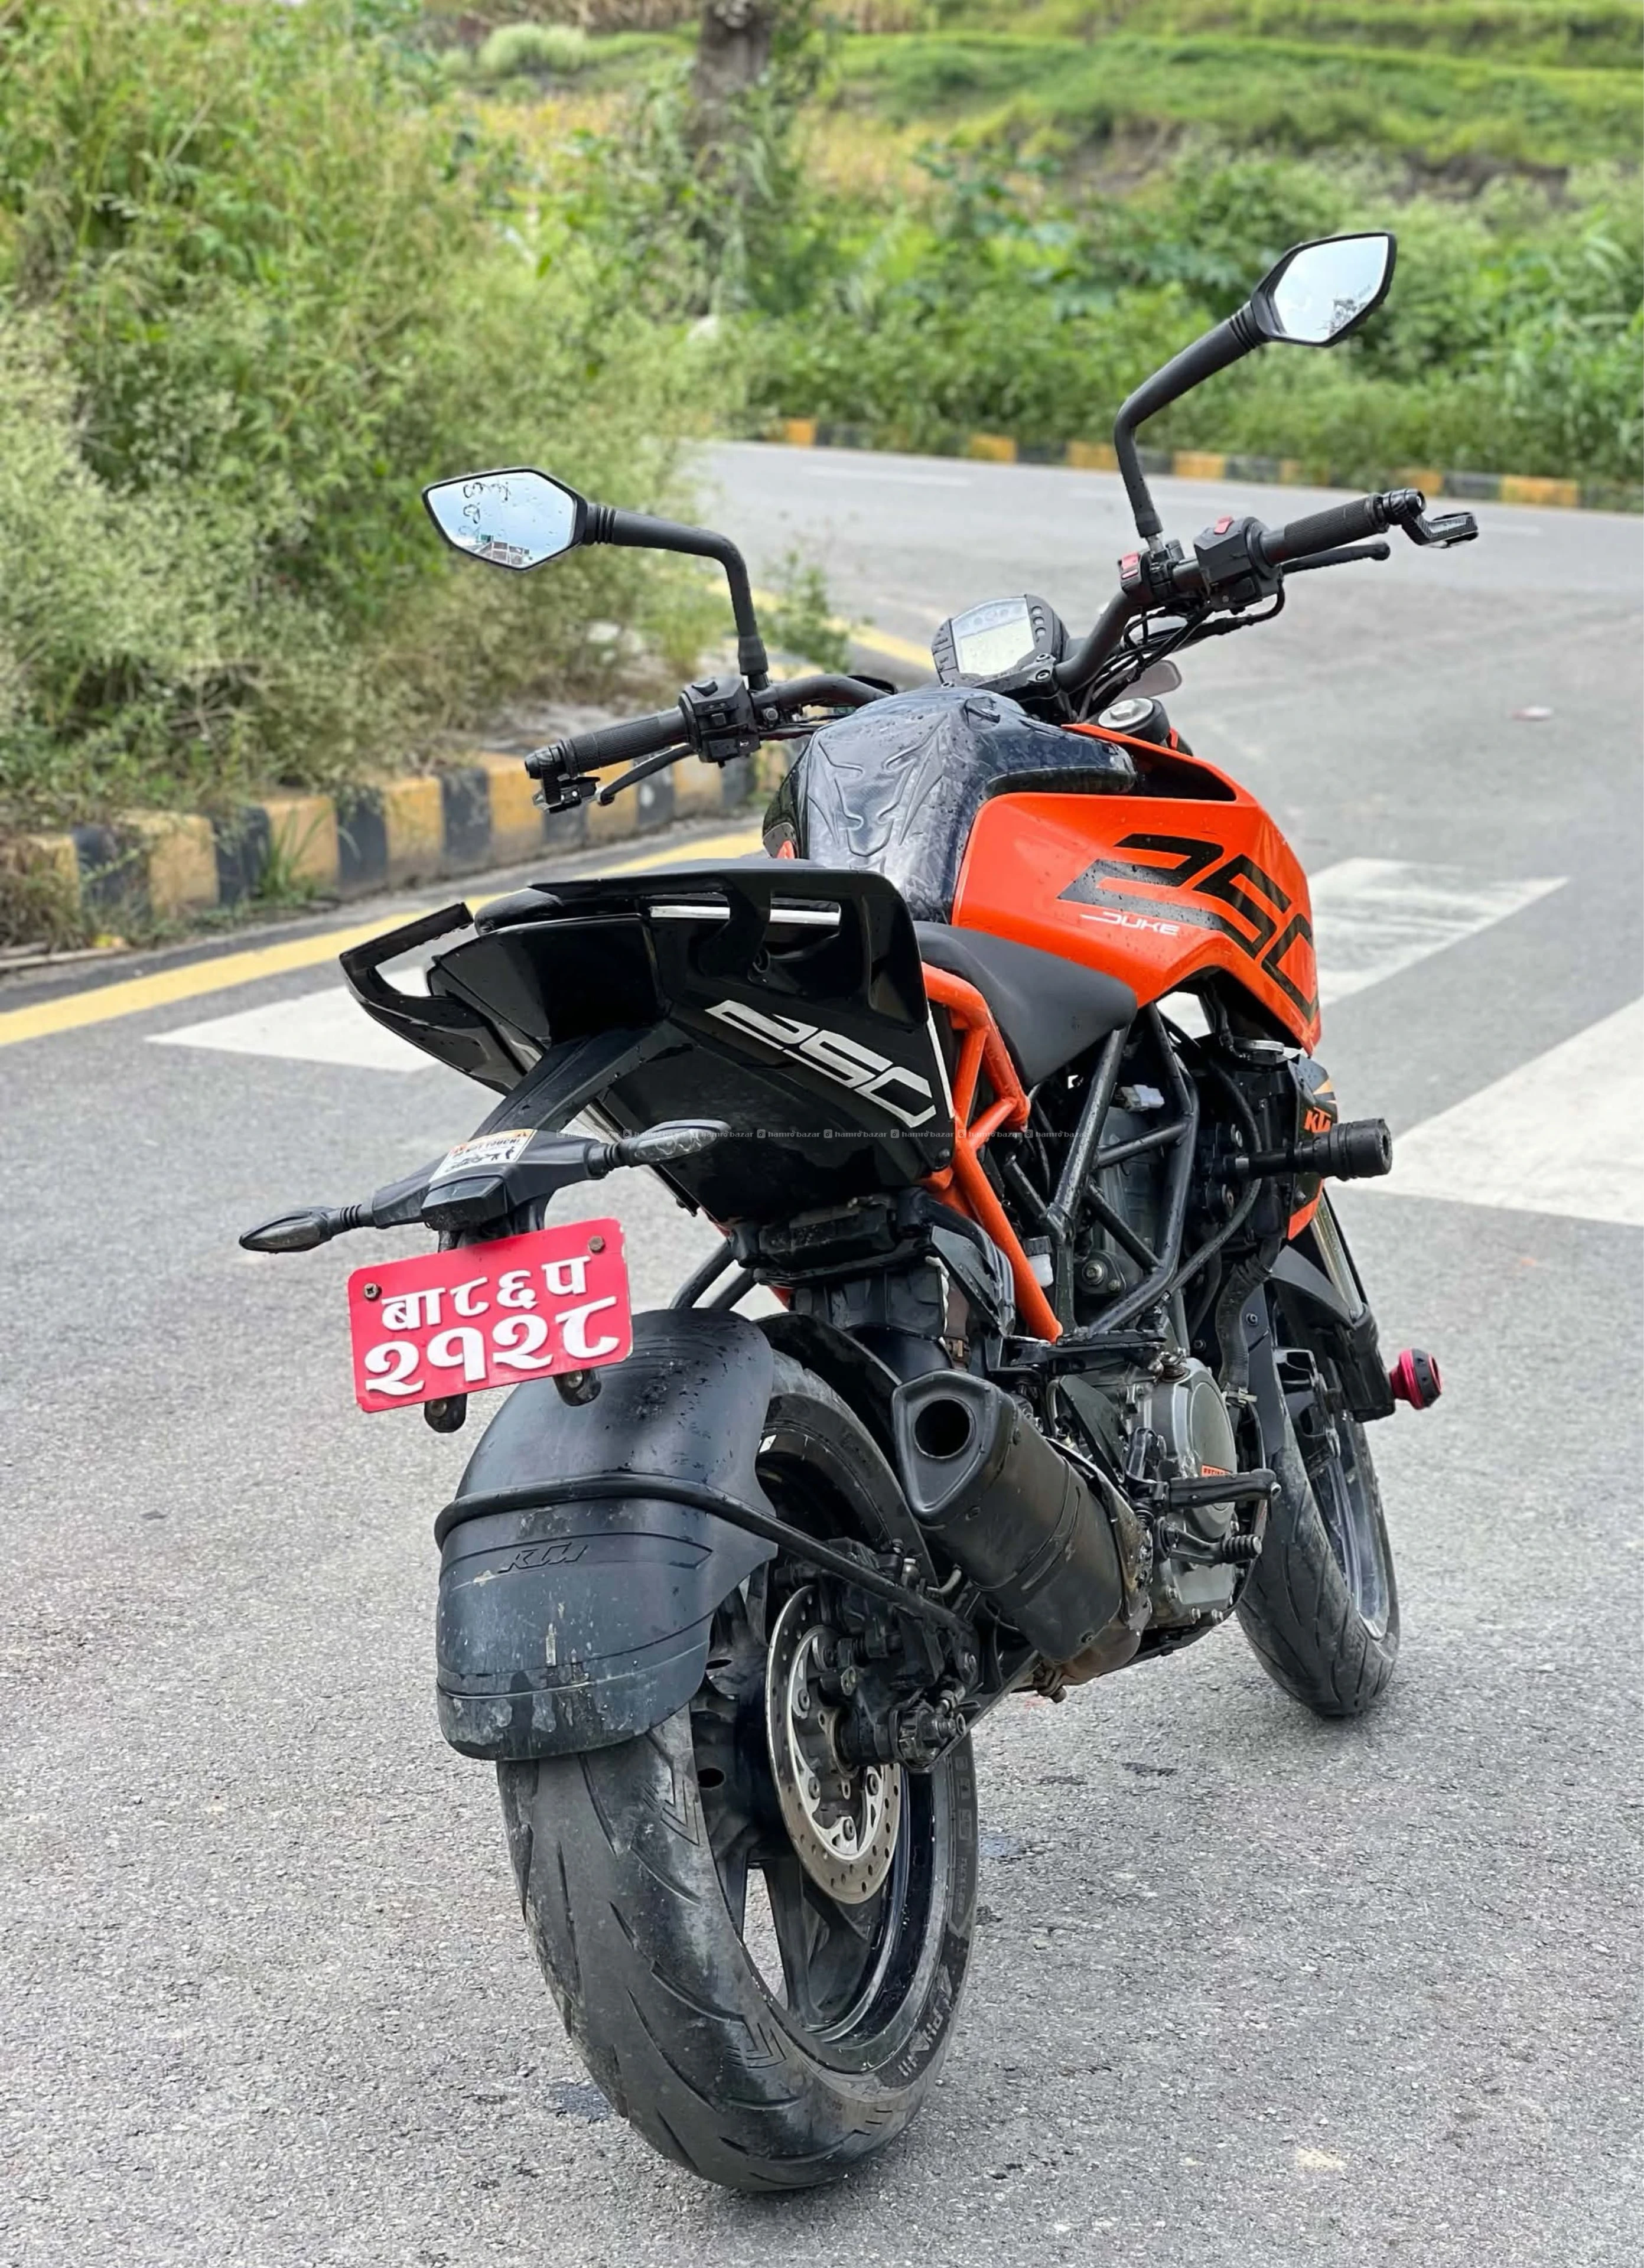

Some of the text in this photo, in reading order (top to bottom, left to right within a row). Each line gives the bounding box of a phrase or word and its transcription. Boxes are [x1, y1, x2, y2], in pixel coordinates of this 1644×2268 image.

[1080, 911, 1180, 936] DUKE
[705, 999, 937, 1129] 250
[364, 1295, 620, 1397] २१२८
[497, 1542, 589, 1574] KTM
